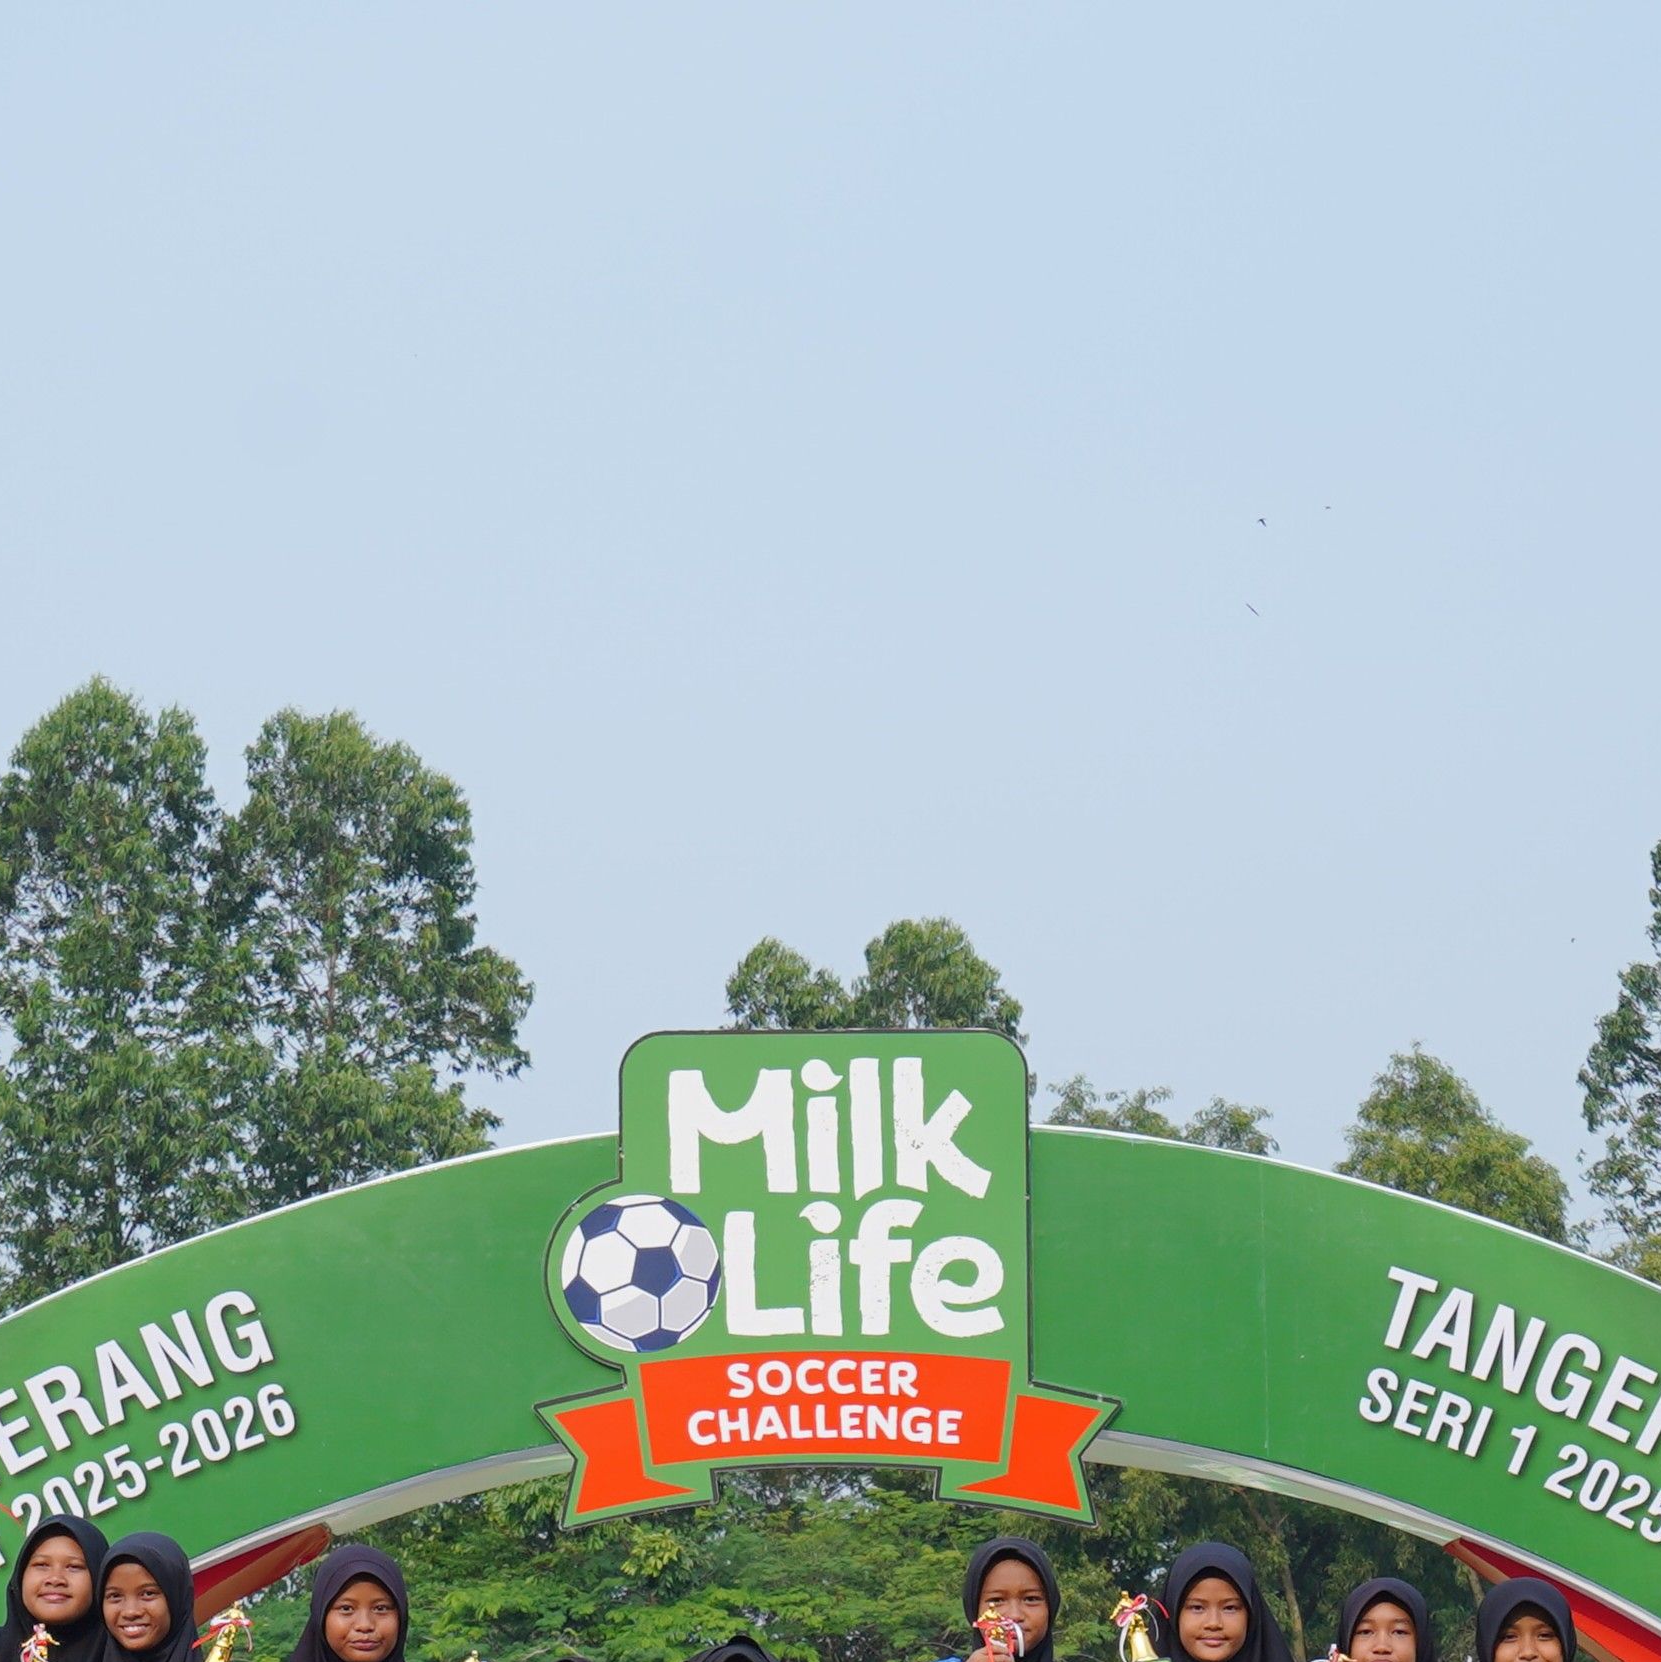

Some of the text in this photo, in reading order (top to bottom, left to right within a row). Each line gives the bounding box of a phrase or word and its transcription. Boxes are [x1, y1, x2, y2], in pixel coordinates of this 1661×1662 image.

[668, 1057, 992, 1200] Milk
[723, 1199, 1005, 1338] Life
[687, 1404, 963, 1445] CHALLENGE
[728, 1360, 918, 1398] SOCCER
[1359, 1368, 1493, 1457] SERI
[1508, 1424, 1536, 1475] 1
